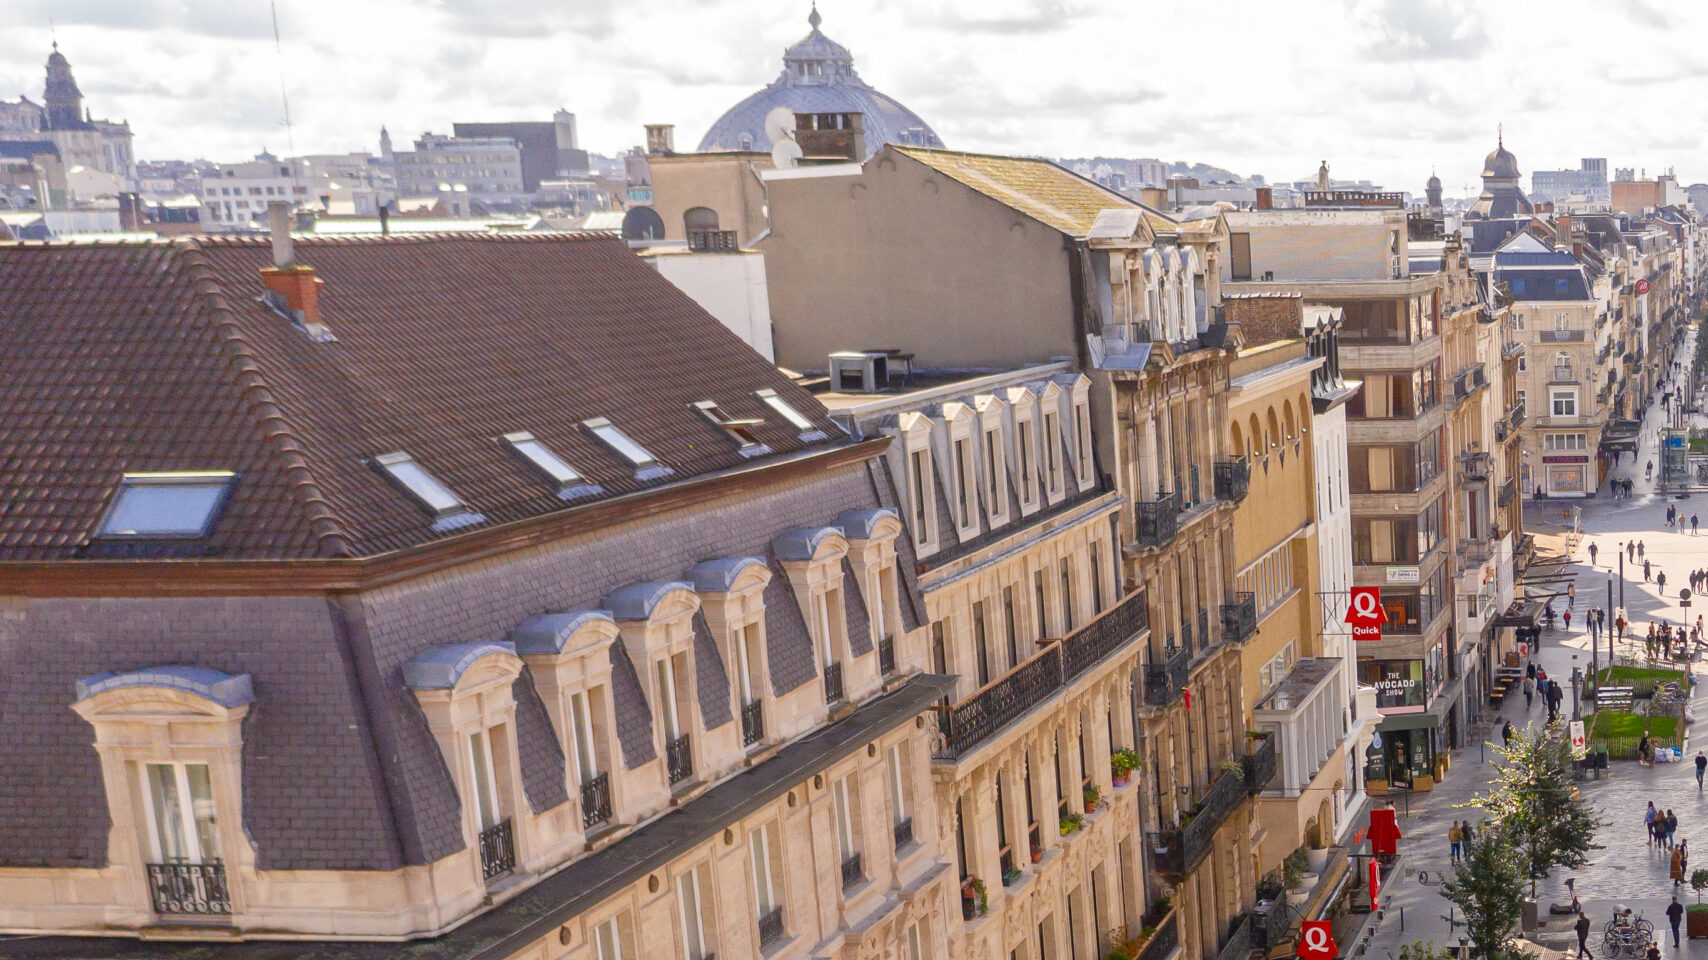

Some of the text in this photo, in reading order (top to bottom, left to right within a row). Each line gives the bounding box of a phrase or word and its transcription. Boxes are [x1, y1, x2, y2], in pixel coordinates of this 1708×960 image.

[1353, 592, 1378, 619] Q
[1353, 626, 1379, 635] Quick
[1387, 672, 1400, 680] THE
[1374, 680, 1415, 690] AVOCADO
[1385, 689, 1404, 697] SHOW
[1305, 927, 1329, 952] Q
